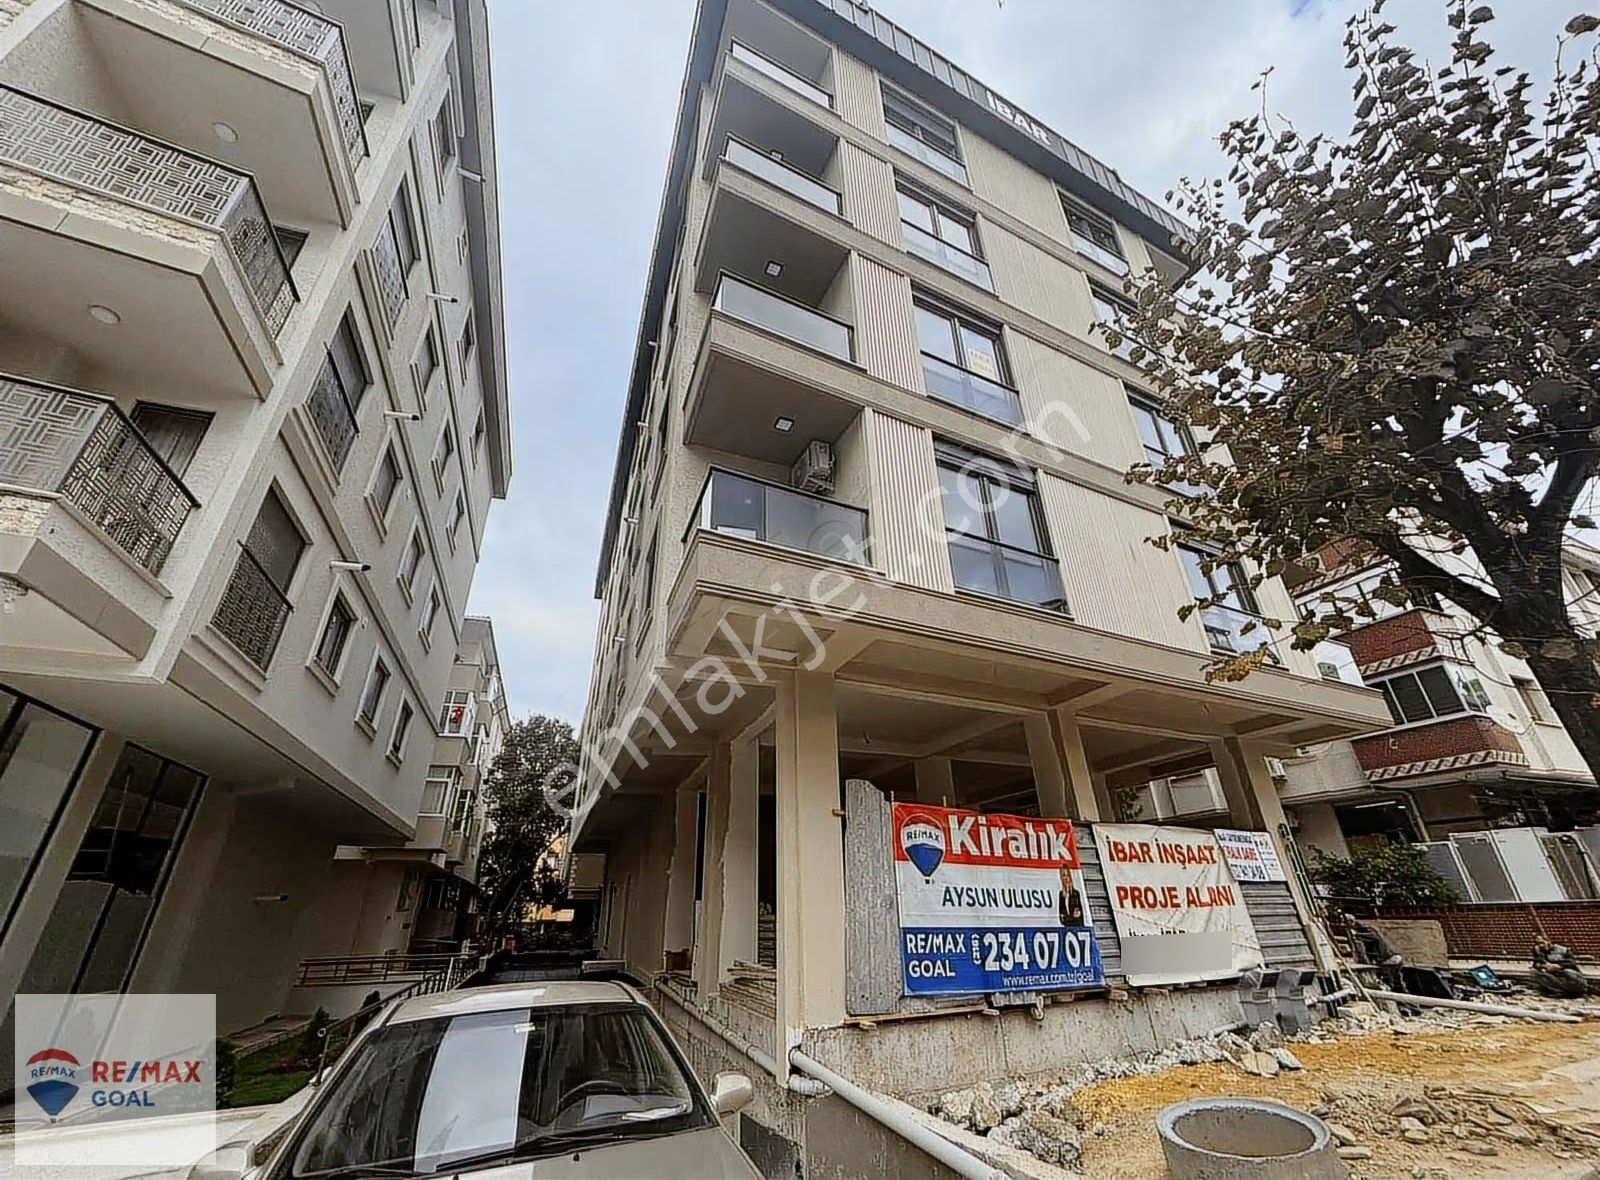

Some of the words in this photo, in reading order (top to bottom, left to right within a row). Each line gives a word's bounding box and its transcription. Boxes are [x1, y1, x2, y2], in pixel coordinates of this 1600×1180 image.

[906, 829, 940, 842] RE/MAX
[948, 814, 1073, 861] Kiralık
[1105, 835, 1154, 863] İBAR
[1155, 838, 1217, 869] İNŞAAT
[942, 886, 999, 908] AYSUN
[1000, 888, 1053, 909] ULUSU
[1115, 885, 1181, 909] PROJE
[906, 933, 967, 954] RE/MAX
[983, 932, 1030, 971] 234
[1033, 931, 1059, 969] 07
[1064, 931, 1091, 968] 07
[908, 960, 956, 978] GOAL
